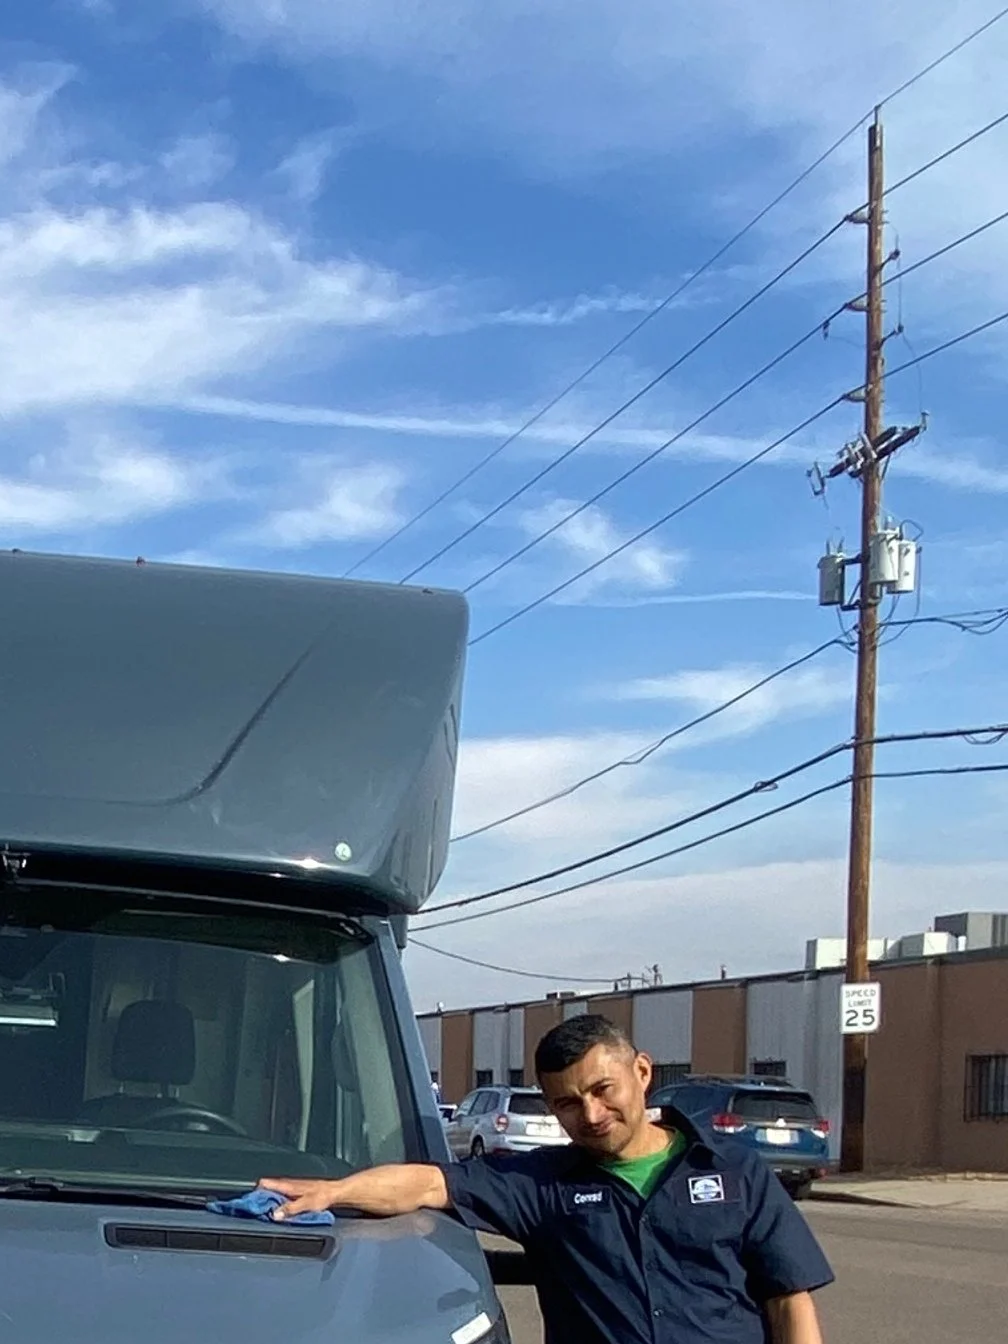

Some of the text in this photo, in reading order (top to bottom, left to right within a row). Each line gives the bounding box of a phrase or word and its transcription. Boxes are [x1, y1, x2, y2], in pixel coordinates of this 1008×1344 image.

[845, 989, 877, 998] SPEED
[847, 998, 872, 1007] LIMIT
[845, 1008, 875, 1027] 25
